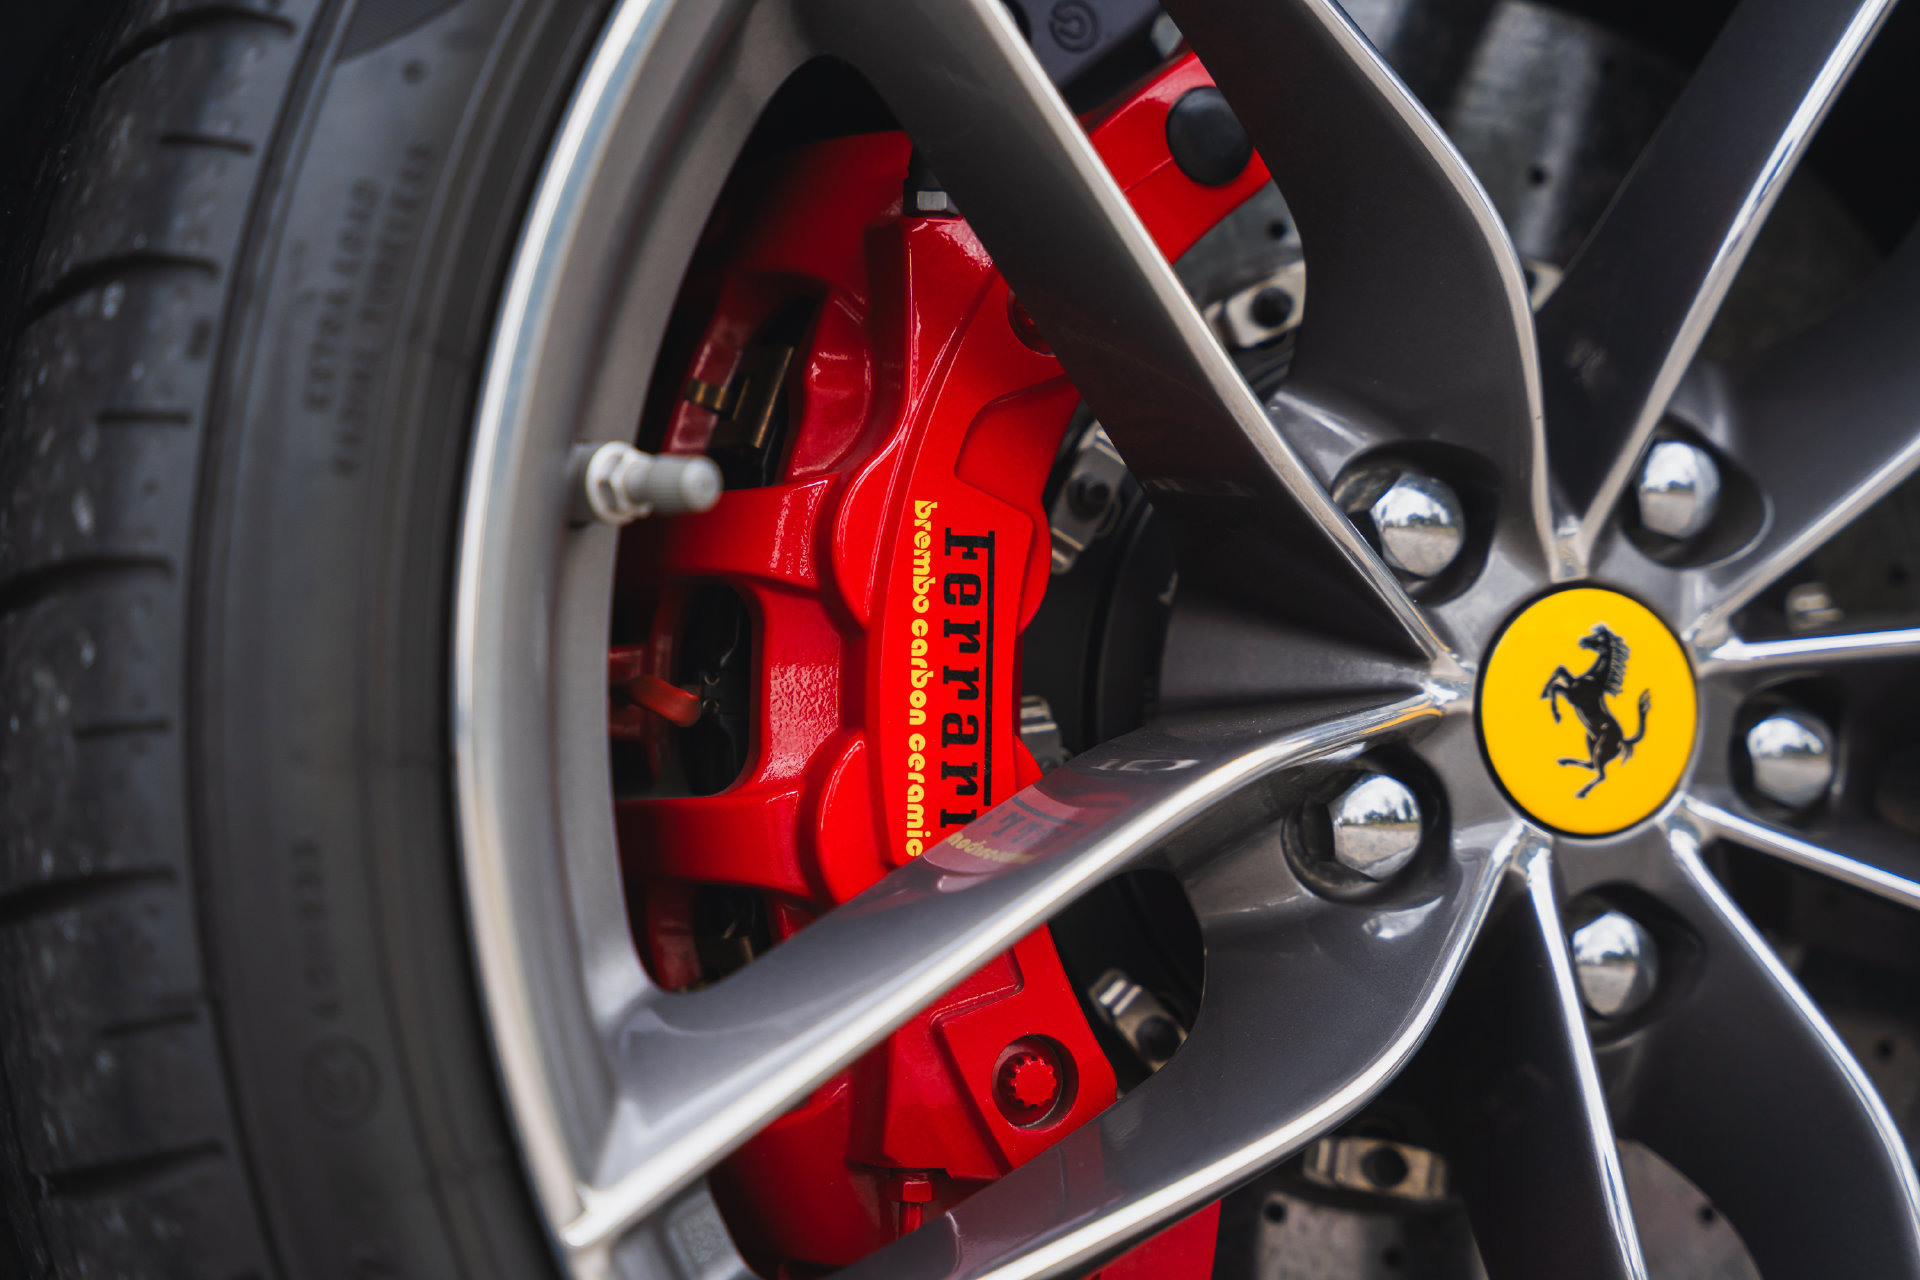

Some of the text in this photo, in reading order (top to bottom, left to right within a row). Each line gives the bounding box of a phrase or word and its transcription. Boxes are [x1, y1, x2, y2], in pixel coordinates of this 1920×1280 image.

[905, 500, 938, 857] brembo carbon ceramic
